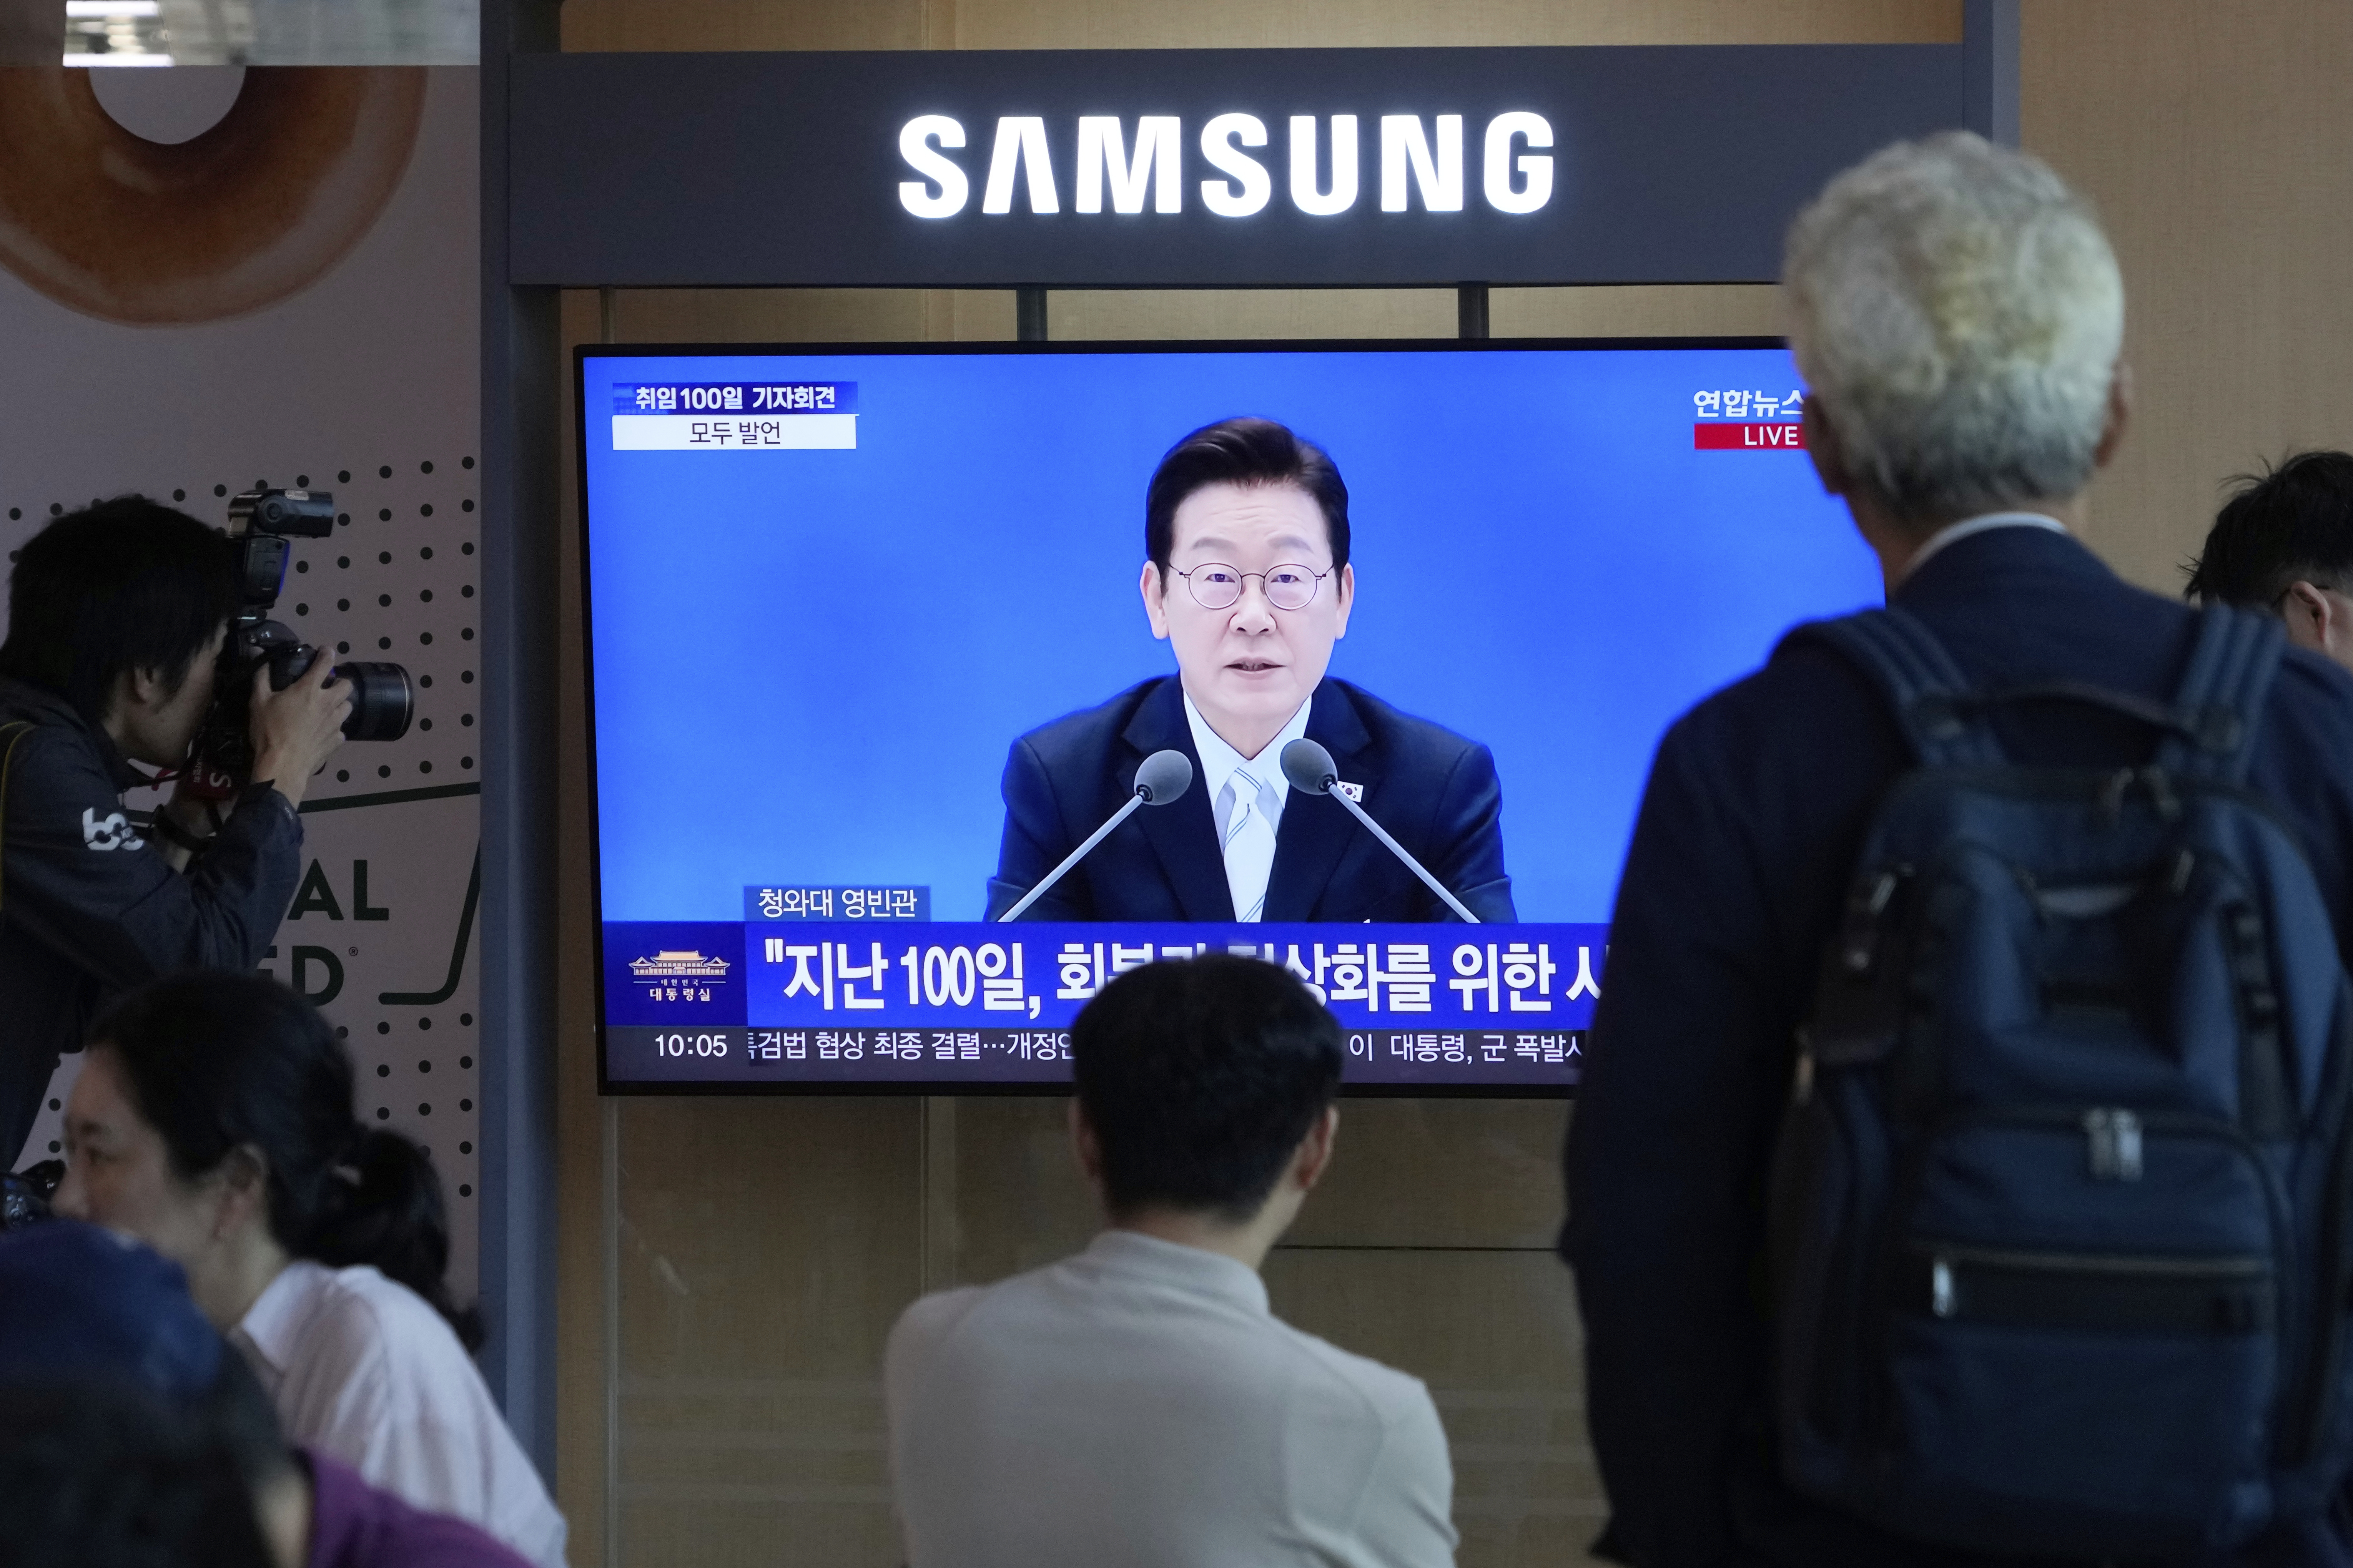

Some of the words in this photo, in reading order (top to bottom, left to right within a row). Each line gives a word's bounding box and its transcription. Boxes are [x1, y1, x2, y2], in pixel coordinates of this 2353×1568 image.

[898, 111, 1555, 219] SAMSUNG
[753, 386, 835, 409] 기자회견
[690, 422, 732, 445] 모두
[740, 422, 780, 444] 발언
[1744, 425, 1799, 446] LIVE
[758, 889, 833, 918] 청와대
[841, 889, 918, 918] 영빈관
[900, 943, 1041, 1020] 100일,
[1227, 942, 1437, 1012] 상화를
[1449, 943, 1556, 1012] 위한
[650, 988, 710, 1001] 대통령실
[655, 1034, 727, 1057] 10:05
[815, 1031, 866, 1060] 협상
[873, 1032, 923, 1060] 최종
[1349, 1033, 1372, 1061] 이
[1391, 1034, 1472, 1065] 대통령,
[1480, 1035, 1507, 1061] 군
